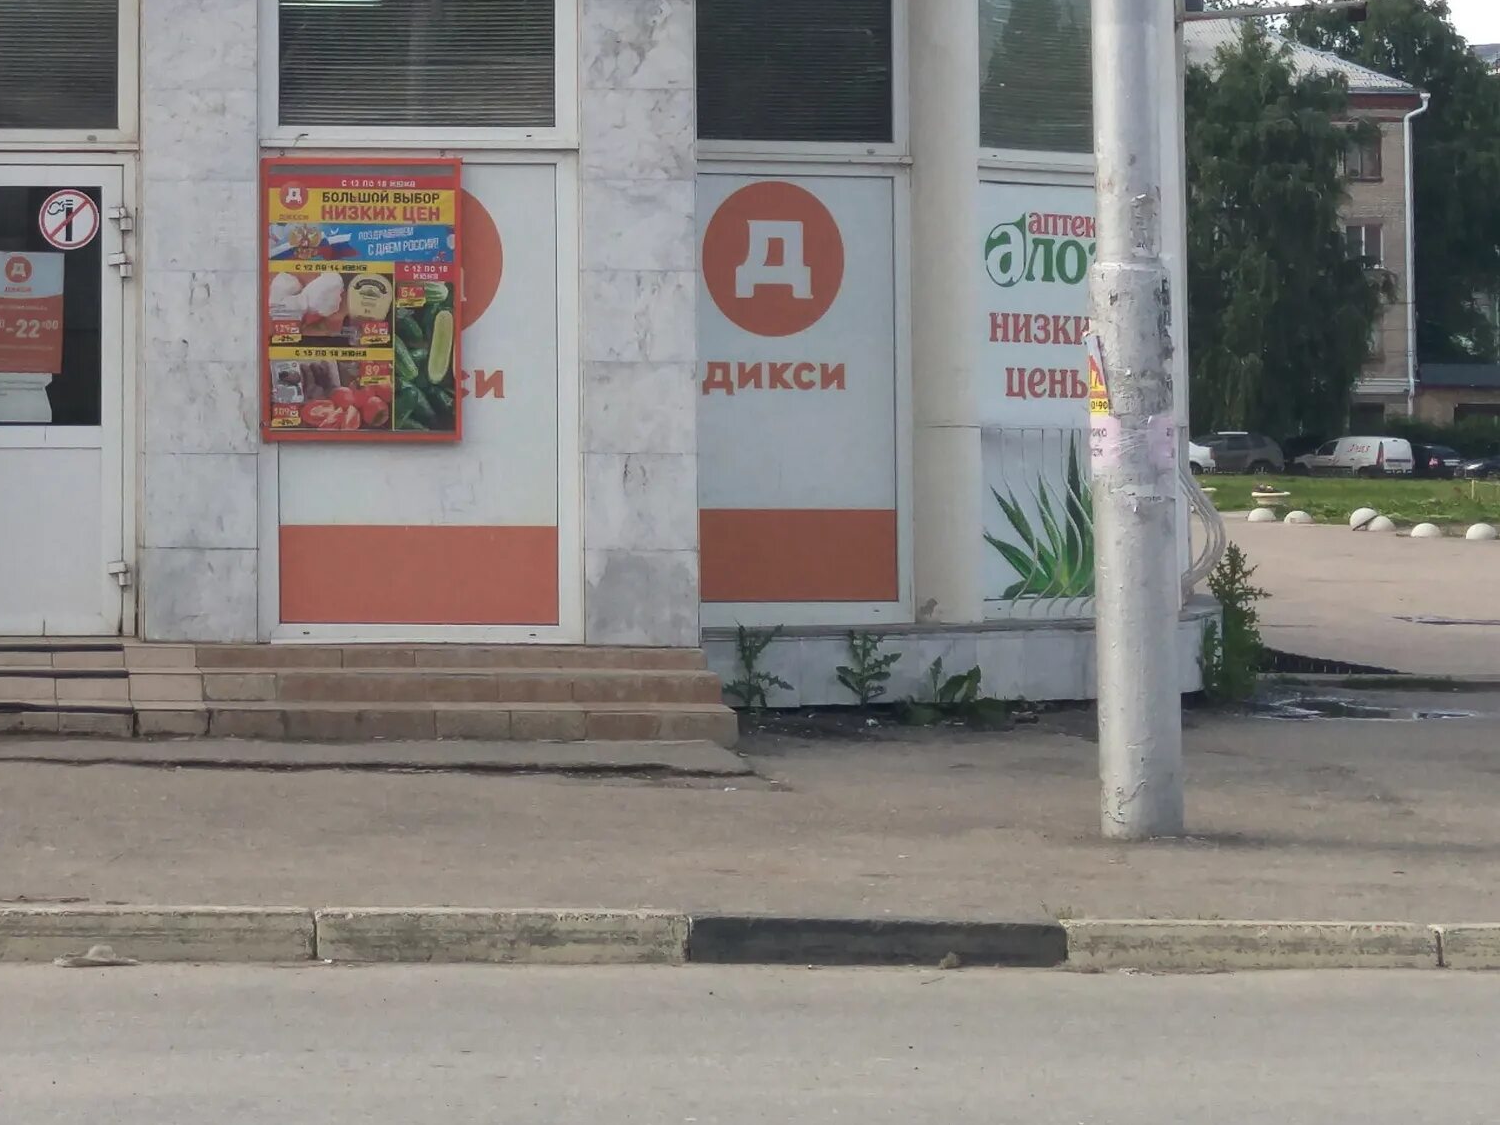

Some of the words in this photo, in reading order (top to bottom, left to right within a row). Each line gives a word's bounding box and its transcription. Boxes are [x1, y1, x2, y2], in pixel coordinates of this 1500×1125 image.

[322, 190, 389, 204] БОЛЬШОЙ
[393, 192, 440, 204] ВЫБОР
[322, 206, 397, 221] НИЗКИХ
[402, 206, 440, 223] ЦЕН
[1028, 212, 1097, 238] аптек
[735, 219, 814, 300] Д
[702, 361, 846, 396] ДИКСИ
